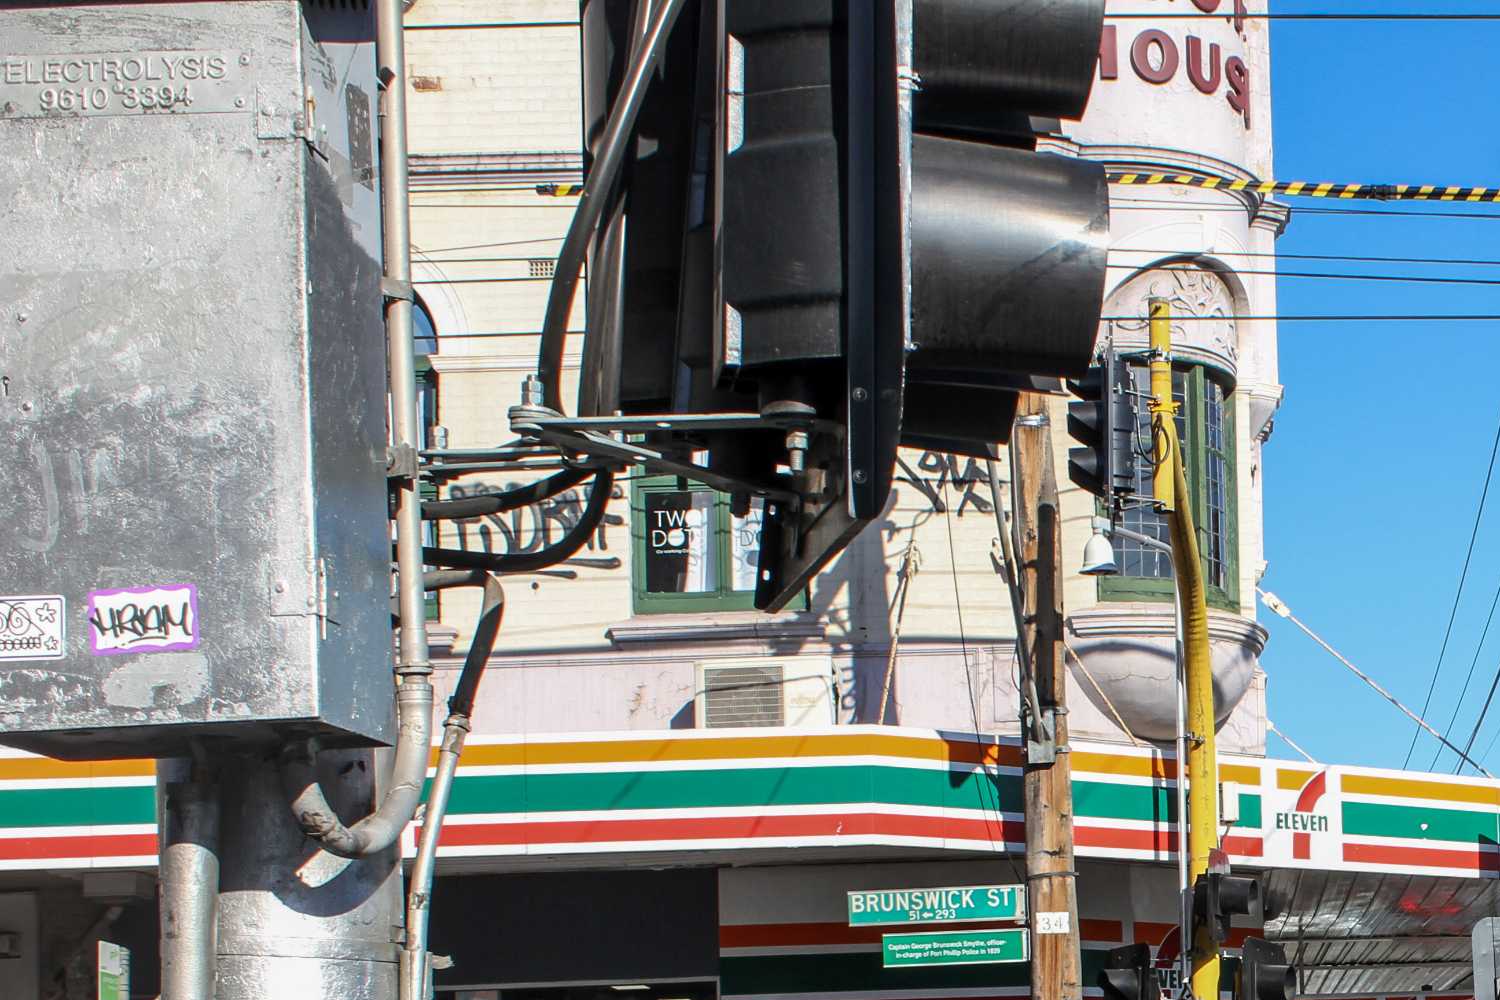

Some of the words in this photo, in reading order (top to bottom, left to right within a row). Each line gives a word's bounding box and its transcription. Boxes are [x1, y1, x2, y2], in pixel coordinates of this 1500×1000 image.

[3, 55, 226, 84] ELECTROLYSIS
[1098, 24, 1250, 130] OUS
[40, 87, 108, 110] 9610
[121, 83, 192, 107] 3394
[852, 889, 975, 913] BRUNSWICK
[988, 888, 1011, 907] ST
[909, 910, 920, 920] 51
[935, 909, 956, 920] 293
